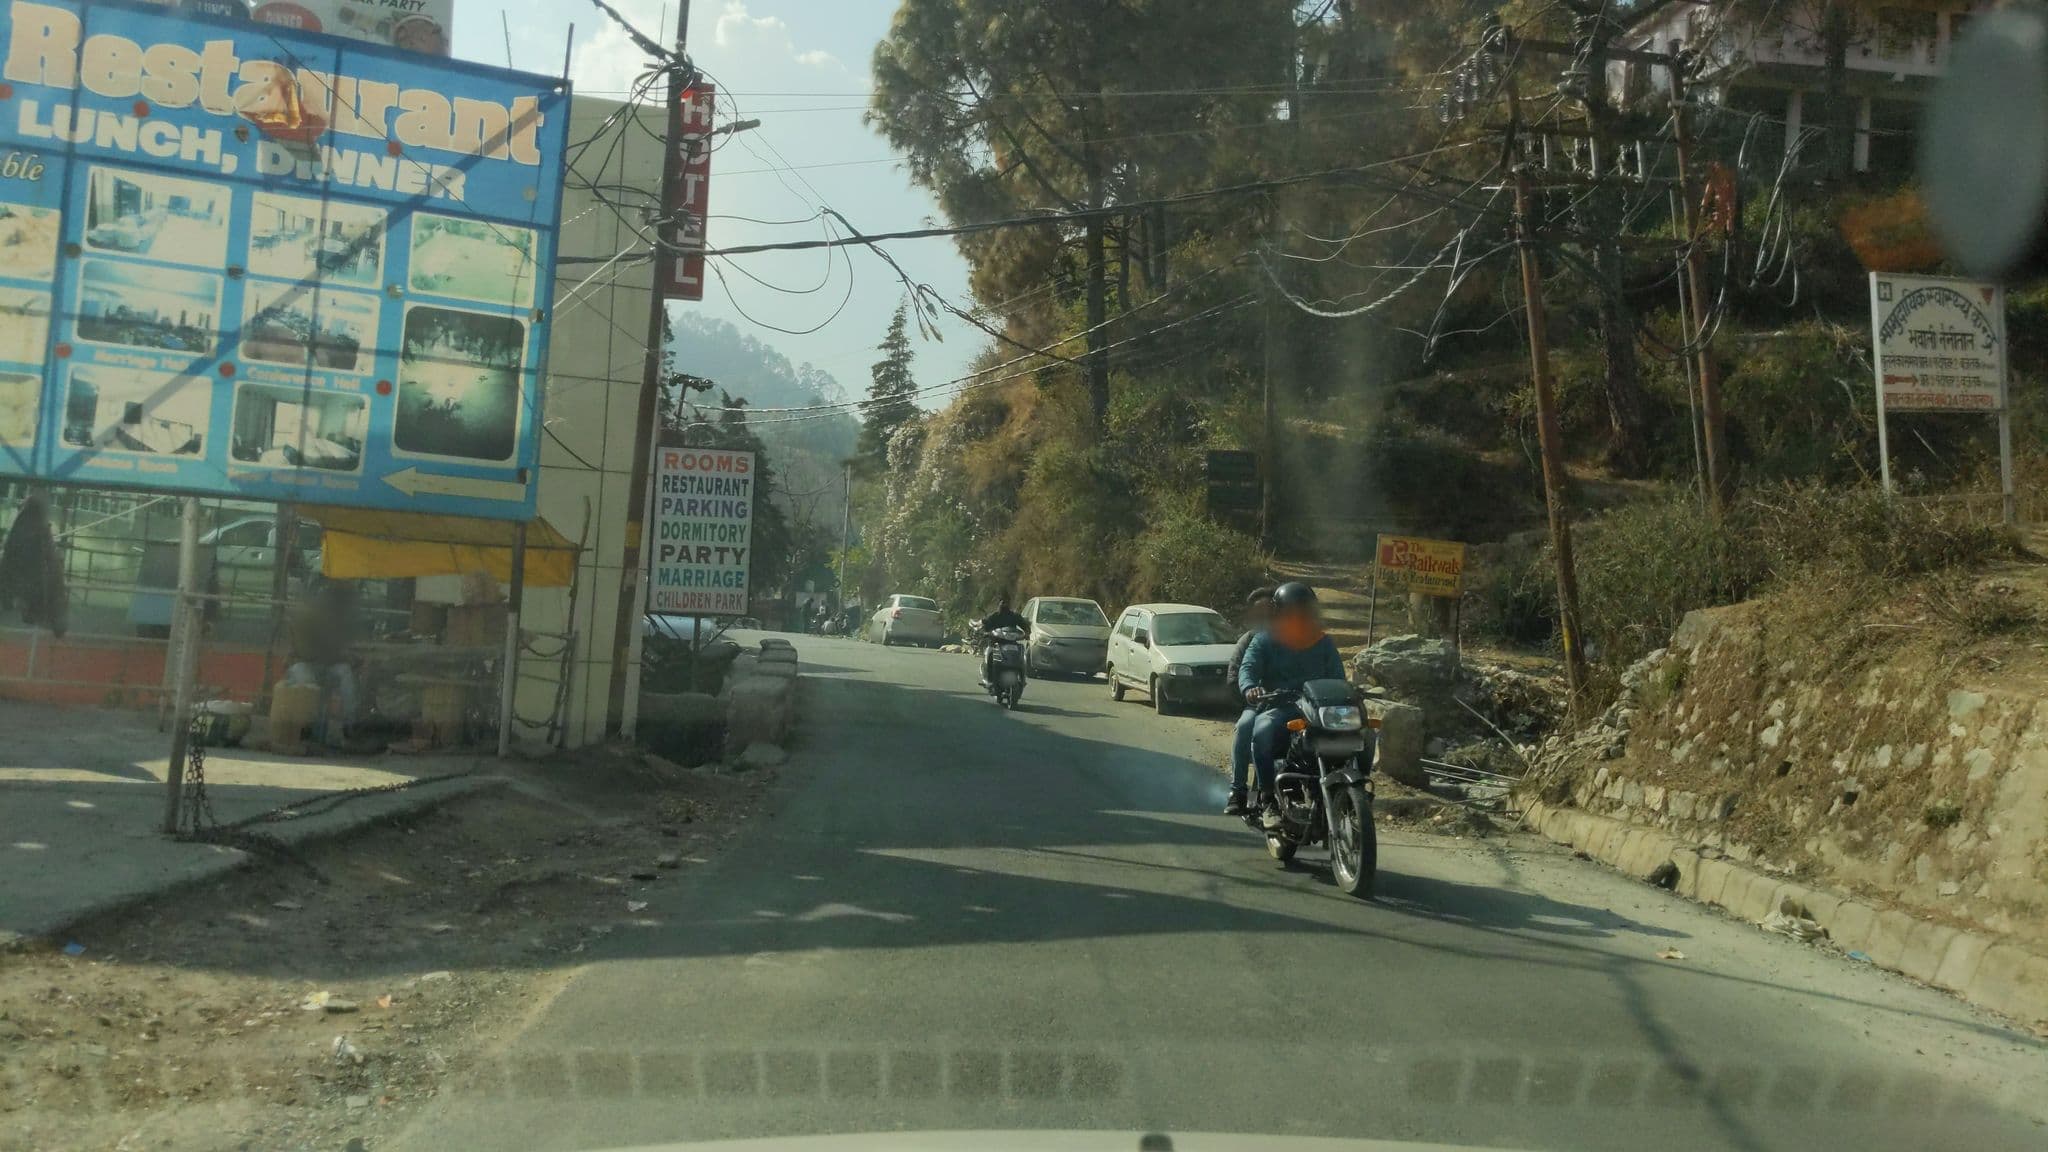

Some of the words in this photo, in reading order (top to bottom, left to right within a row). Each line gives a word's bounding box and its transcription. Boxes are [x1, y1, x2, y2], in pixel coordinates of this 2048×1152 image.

[2, 1, 545, 167] Restaurant
[17, 99, 239, 175] LUNCH,
[255, 139, 469, 203] DINNER
[0, 151, 44, 181] ble
[675, 95, 711, 285] HOTEL
[663, 452, 749, 473] ROOMS
[662, 475, 749, 497] RESTAURANT
[661, 498, 748, 519] PARKING
[660, 521, 747, 543] DORMITORY
[659, 544, 746, 565] PARTY
[658, 568, 745, 589] MARRIAGE
[656, 591, 711, 609] CHILDREN
[716, 592, 743, 610] PARK
